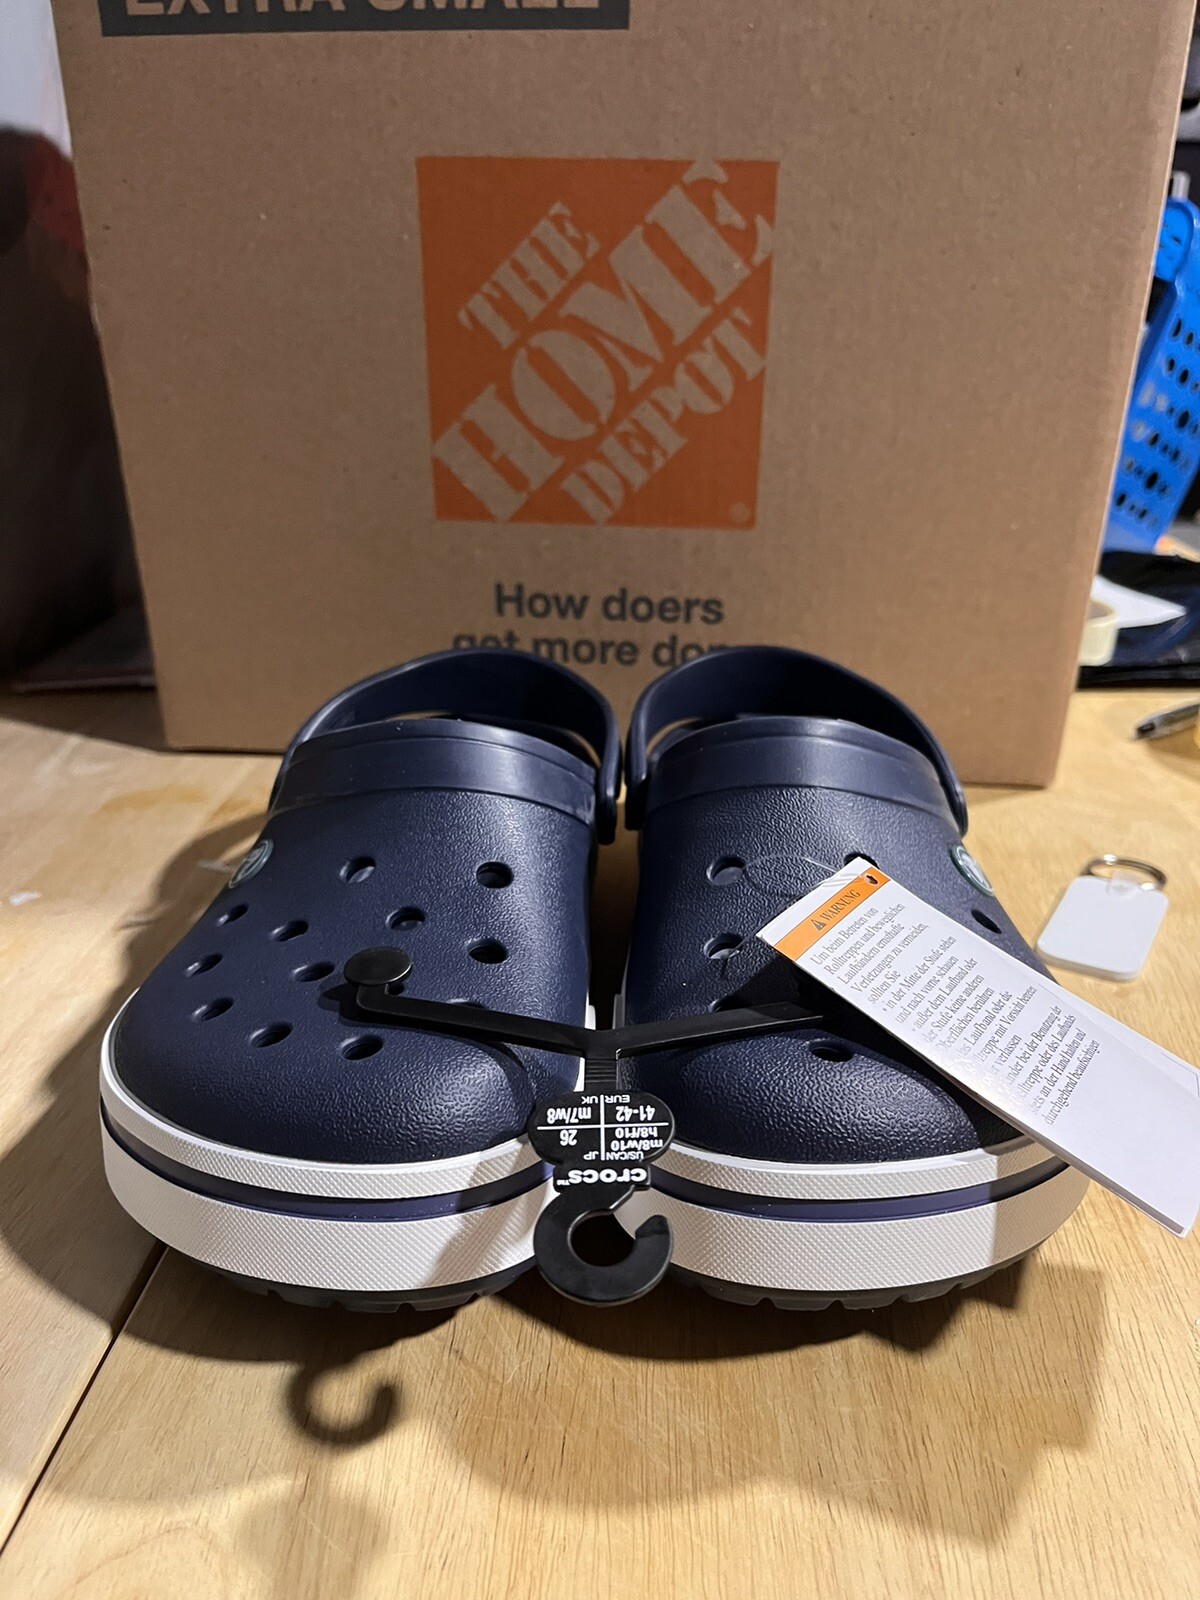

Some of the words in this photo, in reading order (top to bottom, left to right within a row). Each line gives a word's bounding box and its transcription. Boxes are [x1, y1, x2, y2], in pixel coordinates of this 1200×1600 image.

[458, 201, 599, 350] THE
[431, 158, 774, 521] HOME
[560, 306, 767, 522] DEPOT
[494, 582, 590, 620] How
[602, 588, 725, 624] doers
[820, 888, 861, 921] WARNUNG
[810, 952, 830, 965] Um
[822, 937, 845, 953] beim
[838, 917, 868, 939] Betreten
[864, 908, 878, 918] von
[823, 941, 865, 975] Rolltreppen
[860, 928, 875, 942] und
[868, 904, 905, 932] beweglichen
[837, 947, 880, 984] Laufbändern
[876, 923, 904, 949] ernsthafte
[851, 954, 895, 992] Verletzungen
[891, 947, 902, 956] zu
[898, 923, 929, 948] vermeiden,
[882, 1000, 897, 1009] in
[891, 988, 906, 1001] der
[899, 972, 921, 991] Mitte
[916, 962, 930, 974] der
[923, 949, 943, 965] Stufe
[939, 936, 956, 952] stehen
[868, 981, 891, 1004] sollten
[884, 971, 900, 983] Sie
[895, 1006, 911, 1023] und
[907, 992, 925, 1010] nach
[921, 976, 940, 994] vorne
[936, 956, 958, 978] schauen
[913, 1007, 933, 1029] außer
[928, 994, 946, 1010] dem
[939, 966, 968, 996] Laufband
[964, 958, 977, 971] oder
[1016, 986, 1037, 1004] betreten
[931, 1012, 953, 1031] Stufe
[945, 995, 967, 1014] keine
[962, 975, 984, 997] anderen
[967, 988, 994, 1013] berühren
[1000, 1001, 1025, 1025] Vorsicht
[1050, 1006, 1062, 1015] der
[964, 1010, 996, 1045] Laufband
[991, 999, 1005, 1014] oder
[999, 991, 1012, 1001] die
[1031, 1013, 1060, 1042] Benutzung
[994, 1024, 1007, 1038] mit
[1075, 1028, 1086, 1041] und
[995, 1035, 1022, 1065] verlassen
[1015, 1048, 1032, 1063] bei
[1024, 1039, 1039, 1052] der
[1038, 1050, 1052, 1067] oder
[1045, 1040, 1059, 1052] des
[1061, 1039, 1080, 1058] halten
[1051, 1054, 1070, 1075] Hand
[1040, 1086, 1051, 1097] an
[1042, 1073, 1059, 1087] der
[605, 1095, 630, 1103] EUR
[1042, 1075, 1078, 1125] durchgehend
[547, 1107, 591, 1124] m7/w8
[616, 1105, 655, 1121] 41-42
[560, 1130, 577, 1146] 26
[615, 1127, 657, 1138] h8/f10
[584, 1151, 599, 1160] JP
[606, 1151, 644, 1160] US/CAN
[611, 1140, 663, 1151] m8/w10
